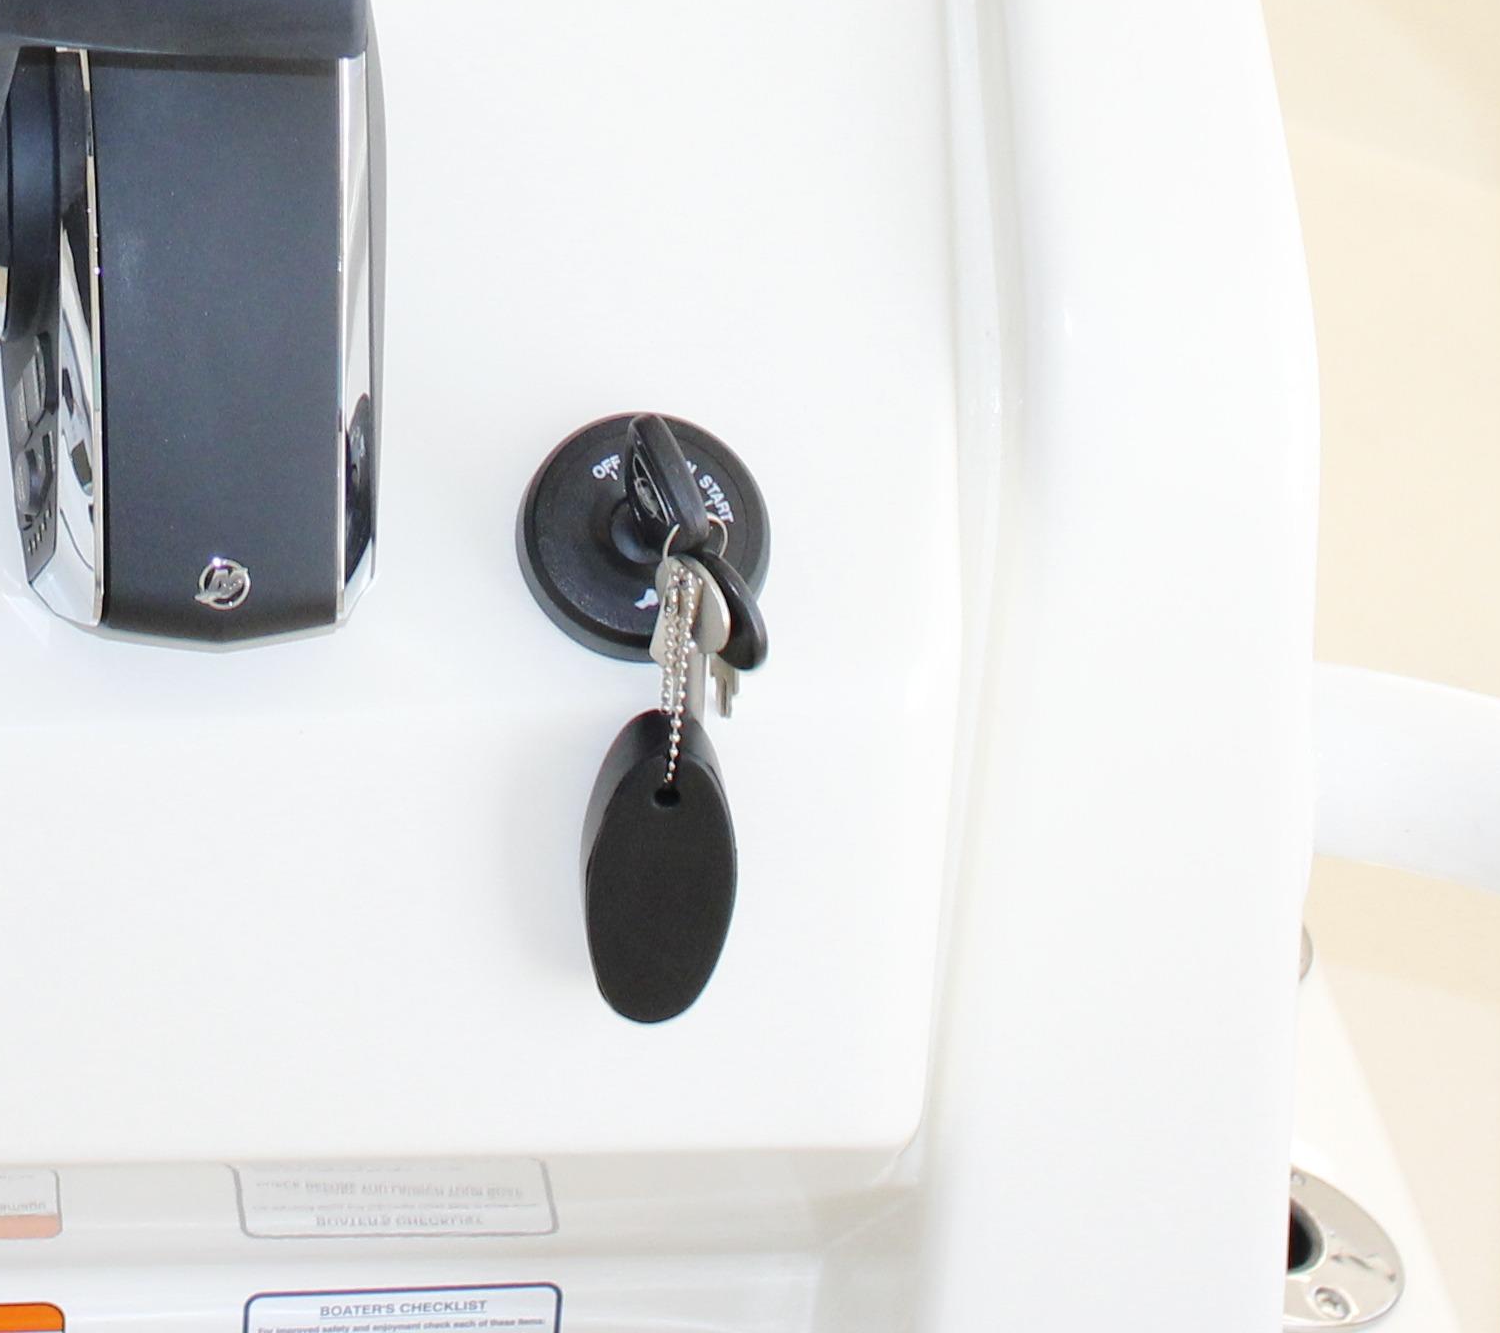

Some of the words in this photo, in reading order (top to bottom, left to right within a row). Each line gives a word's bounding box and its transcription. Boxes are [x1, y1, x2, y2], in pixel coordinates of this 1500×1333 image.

[591, 454, 622, 480] OFF
[699, 474, 735, 524] START
[319, 1303, 395, 1317] BOATER'S
[400, 1300, 487, 1314] CHECKLIST
